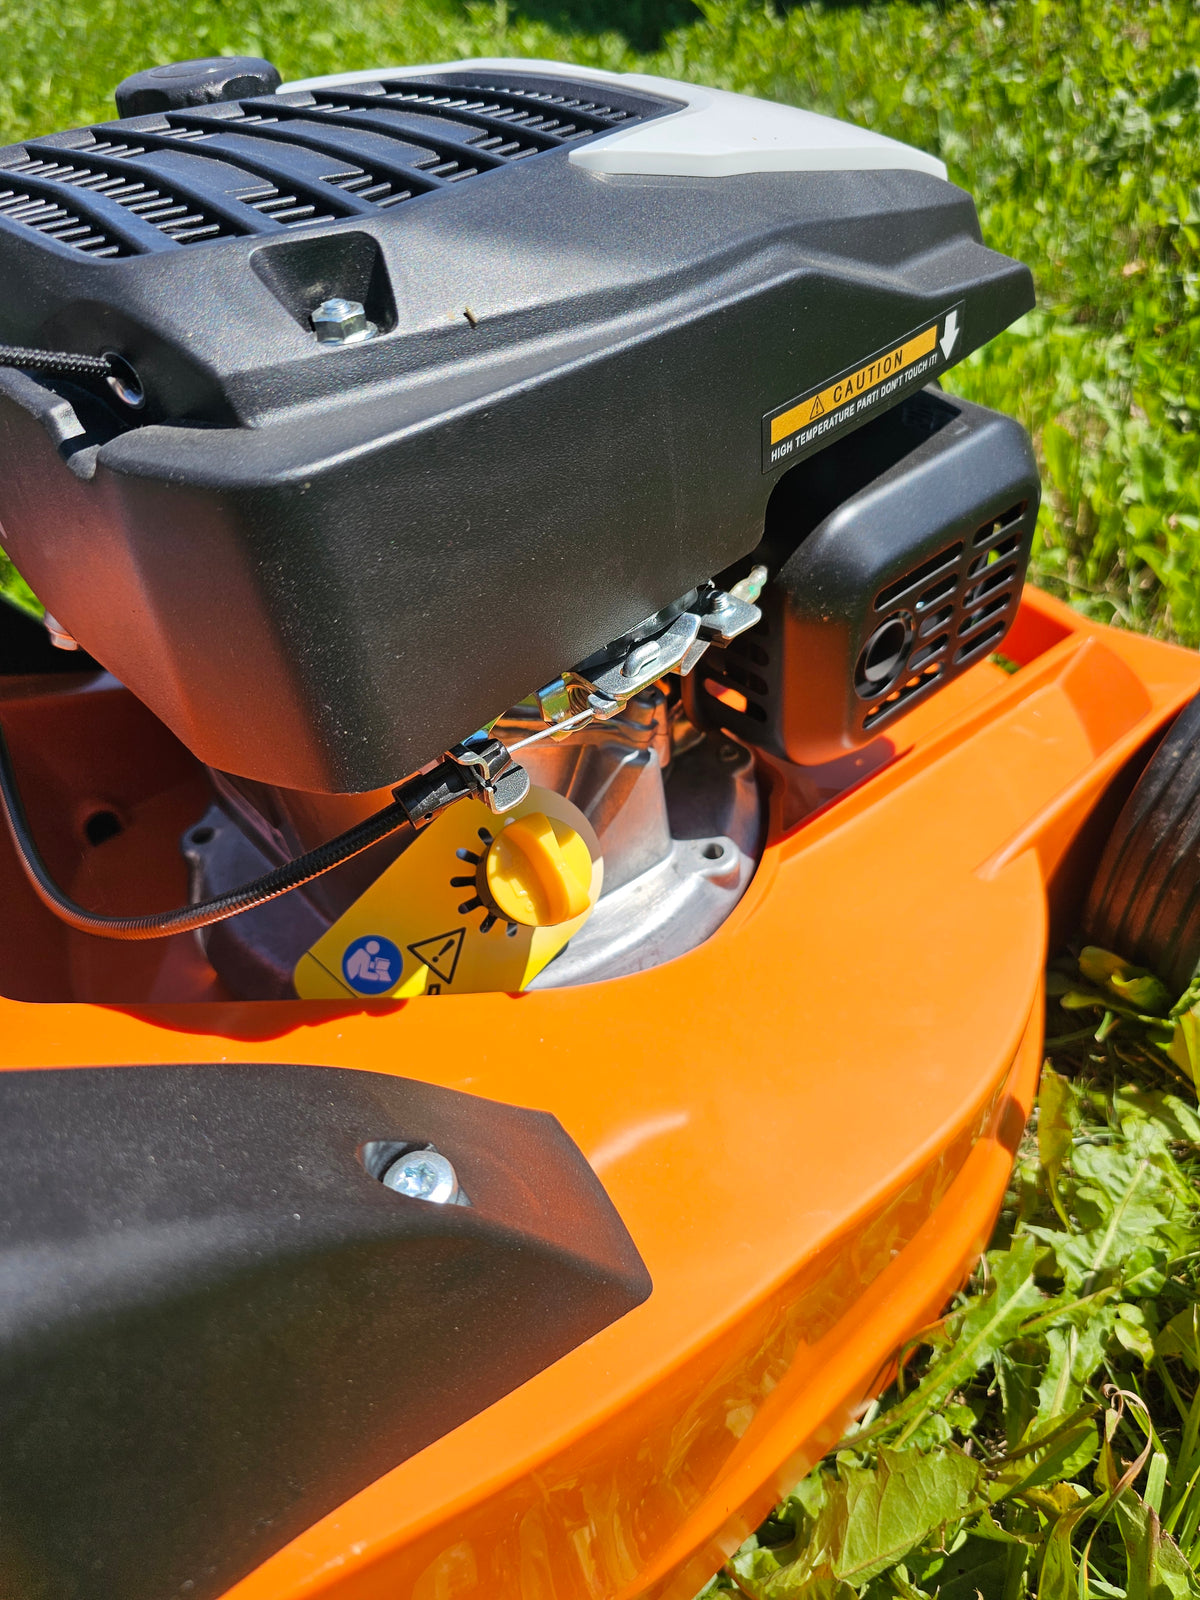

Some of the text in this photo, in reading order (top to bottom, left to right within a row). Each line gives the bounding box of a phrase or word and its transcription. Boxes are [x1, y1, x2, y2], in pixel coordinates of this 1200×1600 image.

[771, 353, 938, 462] HIGH TEMPERATURE PART! DON'T TOUCH IT!
[833, 349, 903, 403] CAUTION
